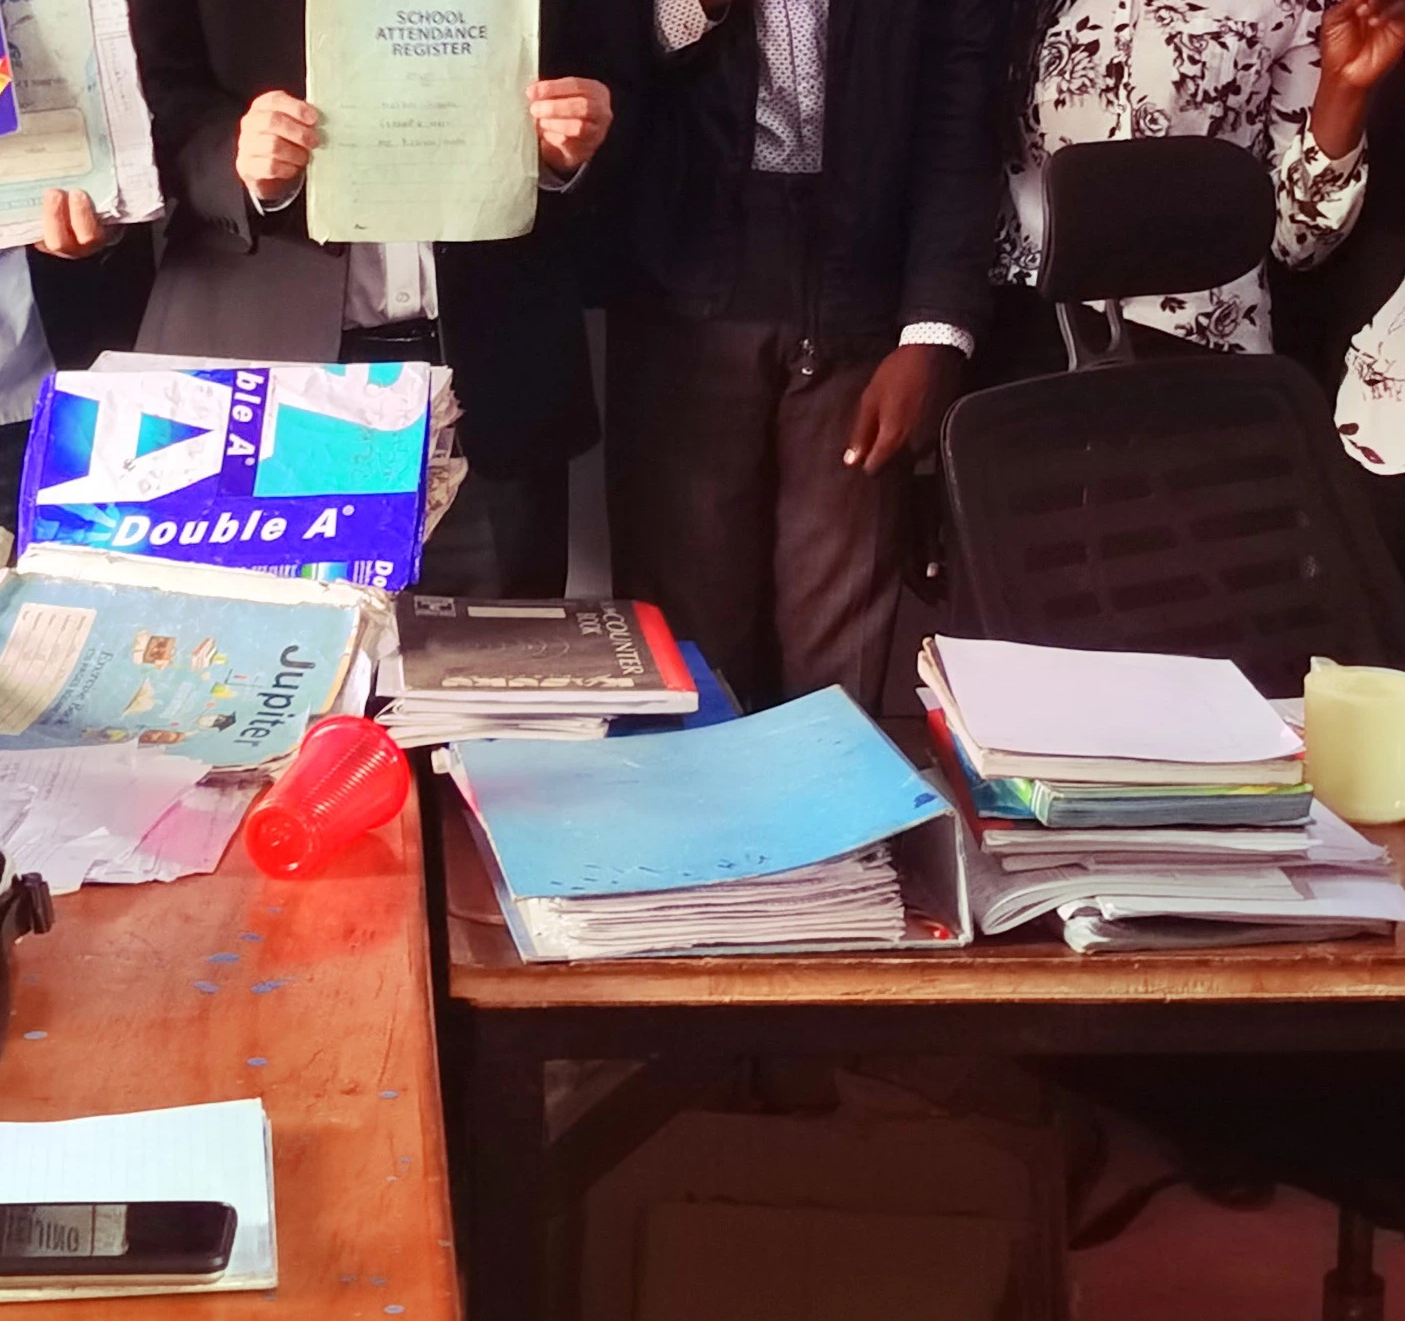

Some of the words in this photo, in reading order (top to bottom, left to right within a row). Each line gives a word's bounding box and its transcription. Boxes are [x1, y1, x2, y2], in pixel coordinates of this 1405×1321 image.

[396, 9, 466, 26] SCHOOL
[376, 25, 489, 41] ATTENDANCE
[392, 41, 473, 57] REGISTER
[112, 509, 288, 547] Double
[601, 611, 645, 676] COUNTER
[233, 644, 317, 748] Jupiter
